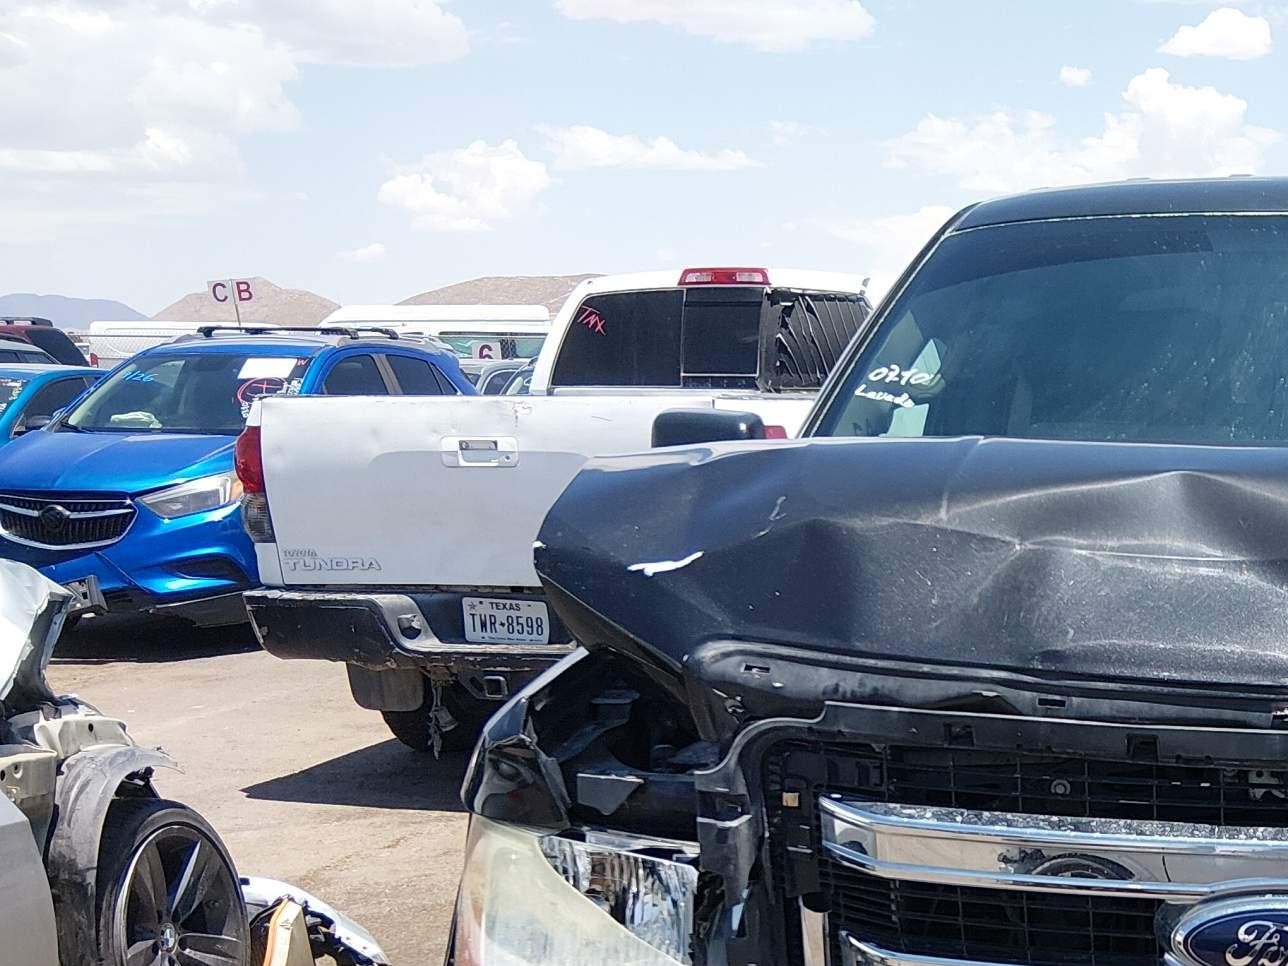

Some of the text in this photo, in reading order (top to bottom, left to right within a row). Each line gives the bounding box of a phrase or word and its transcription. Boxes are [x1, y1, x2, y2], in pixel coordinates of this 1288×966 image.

[212, 282, 228, 302] C
[235, 281, 253, 302] B
[576, 304, 607, 336] TAX
[282, 558, 383, 571] TUNDRA
[488, 601, 521, 611] TEXAS
